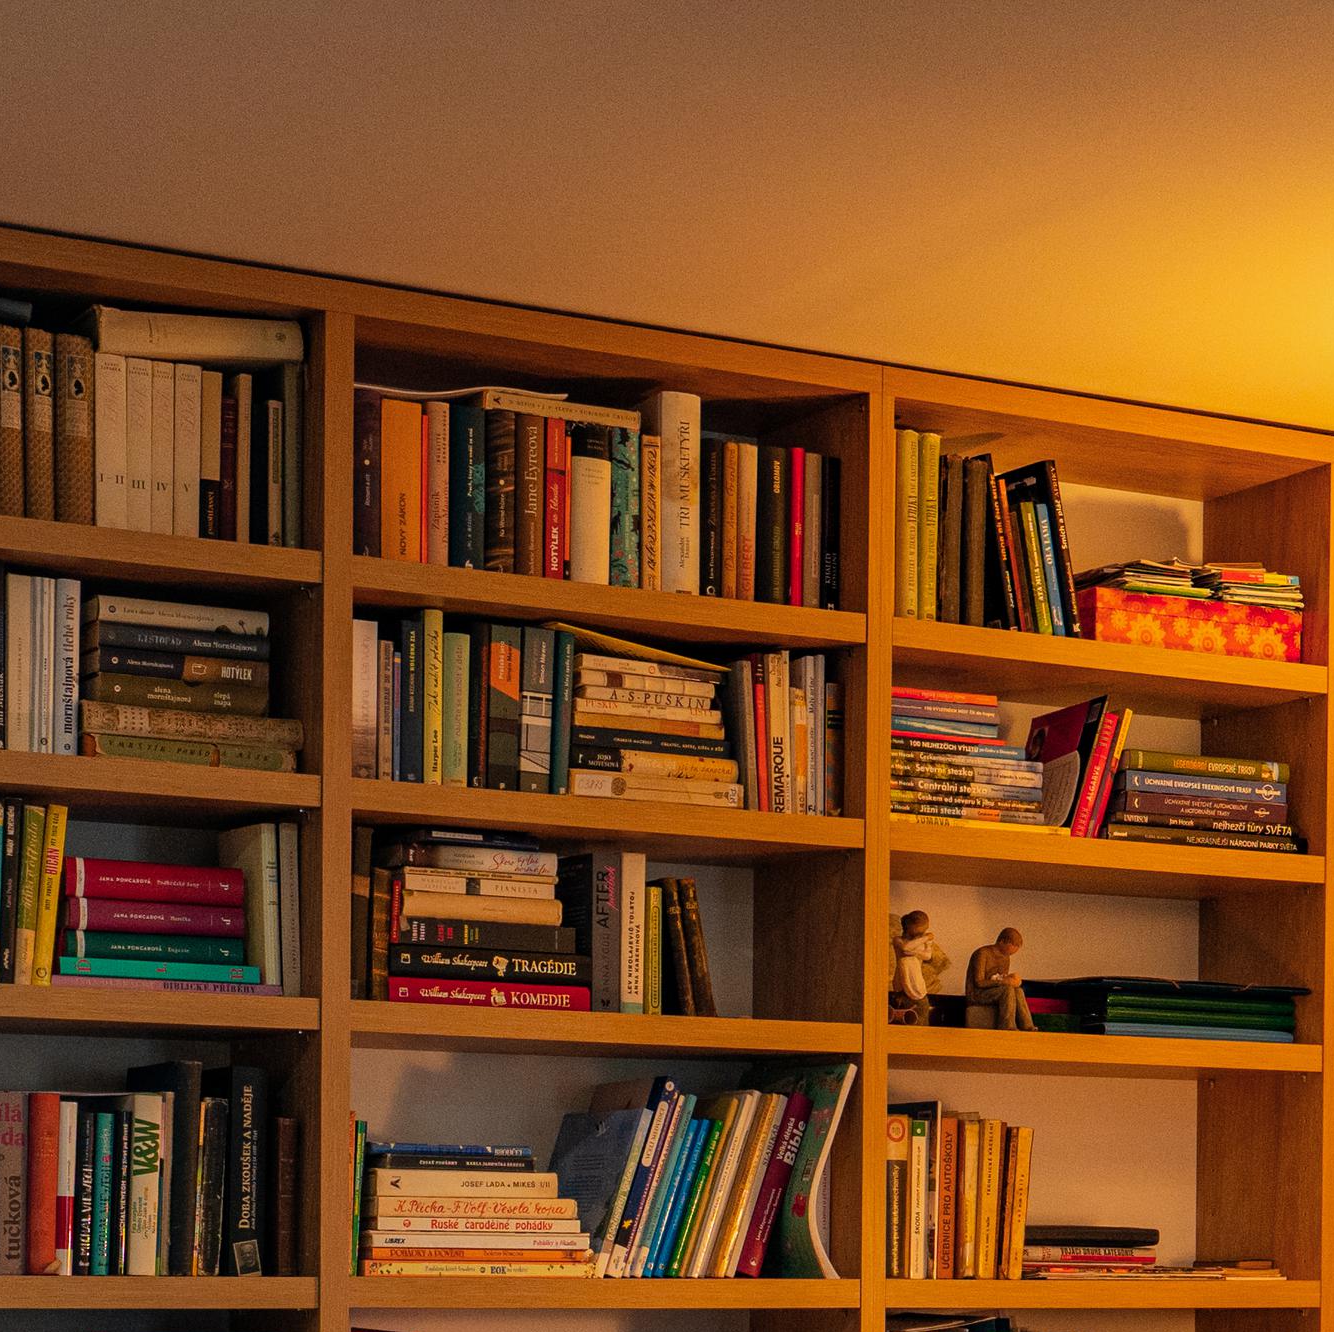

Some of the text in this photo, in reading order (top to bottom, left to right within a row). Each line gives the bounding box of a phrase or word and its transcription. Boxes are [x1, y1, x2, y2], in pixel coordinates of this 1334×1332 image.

[524, 426, 540, 517] Jane Eyreová
[551, 526, 559, 571] HOTÝLEK
[62, 595, 76, 734] mornštajnová tiché roky
[221, 665, 252, 680] HOTÝLEK
[774, 736, 784, 814] REMARQUE
[1265, 823, 1292, 836] SVĚTA
[596, 871, 609, 928] AFTER
[511, 958, 577, 976] TRAGÉDIE
[511, 991, 571, 1008] KOMEDIE
[132, 1118, 160, 1176] V&W
[238, 1085, 255, 1229] DOBA ZKOUŠEK A NADĚJE
[783, 1120, 807, 1166] Bible
[4, 1175, 21, 1260] tučková
[431, 1219, 553, 1230] Ruské čarodějné pohádky
[942, 1131, 953, 1269] UČEBNICE PRO AUTOŠKOLY
